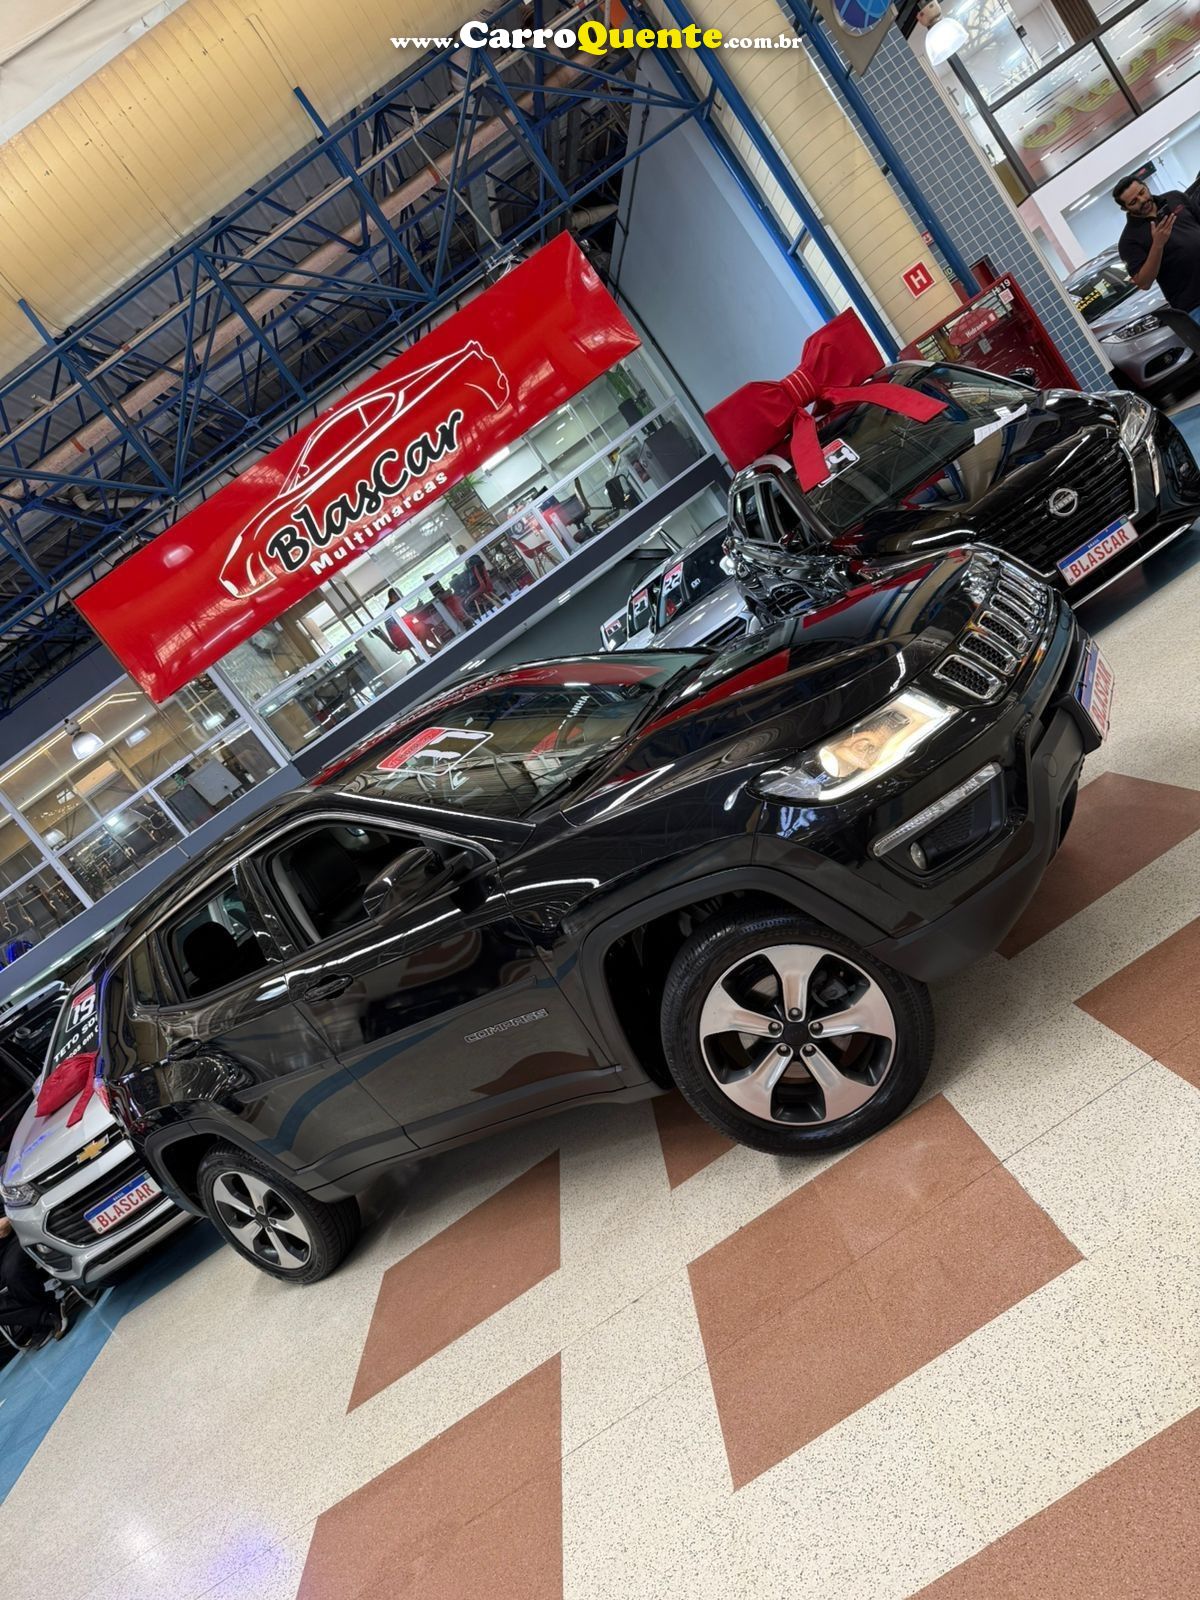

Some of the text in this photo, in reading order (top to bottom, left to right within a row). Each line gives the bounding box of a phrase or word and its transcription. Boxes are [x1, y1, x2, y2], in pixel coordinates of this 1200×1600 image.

[909, 268, 928, 290] H
[266, 408, 464, 573] BlasCar
[309, 471, 448, 576] Multimarcas
[1069, 528, 1130, 579] BLASCAR
[1091, 658, 1112, 730] BLASCAR
[72, 993, 96, 1025] 19
[53, 1033, 80, 1062] TETO
[96, 1182, 155, 1228] BLASCAR
